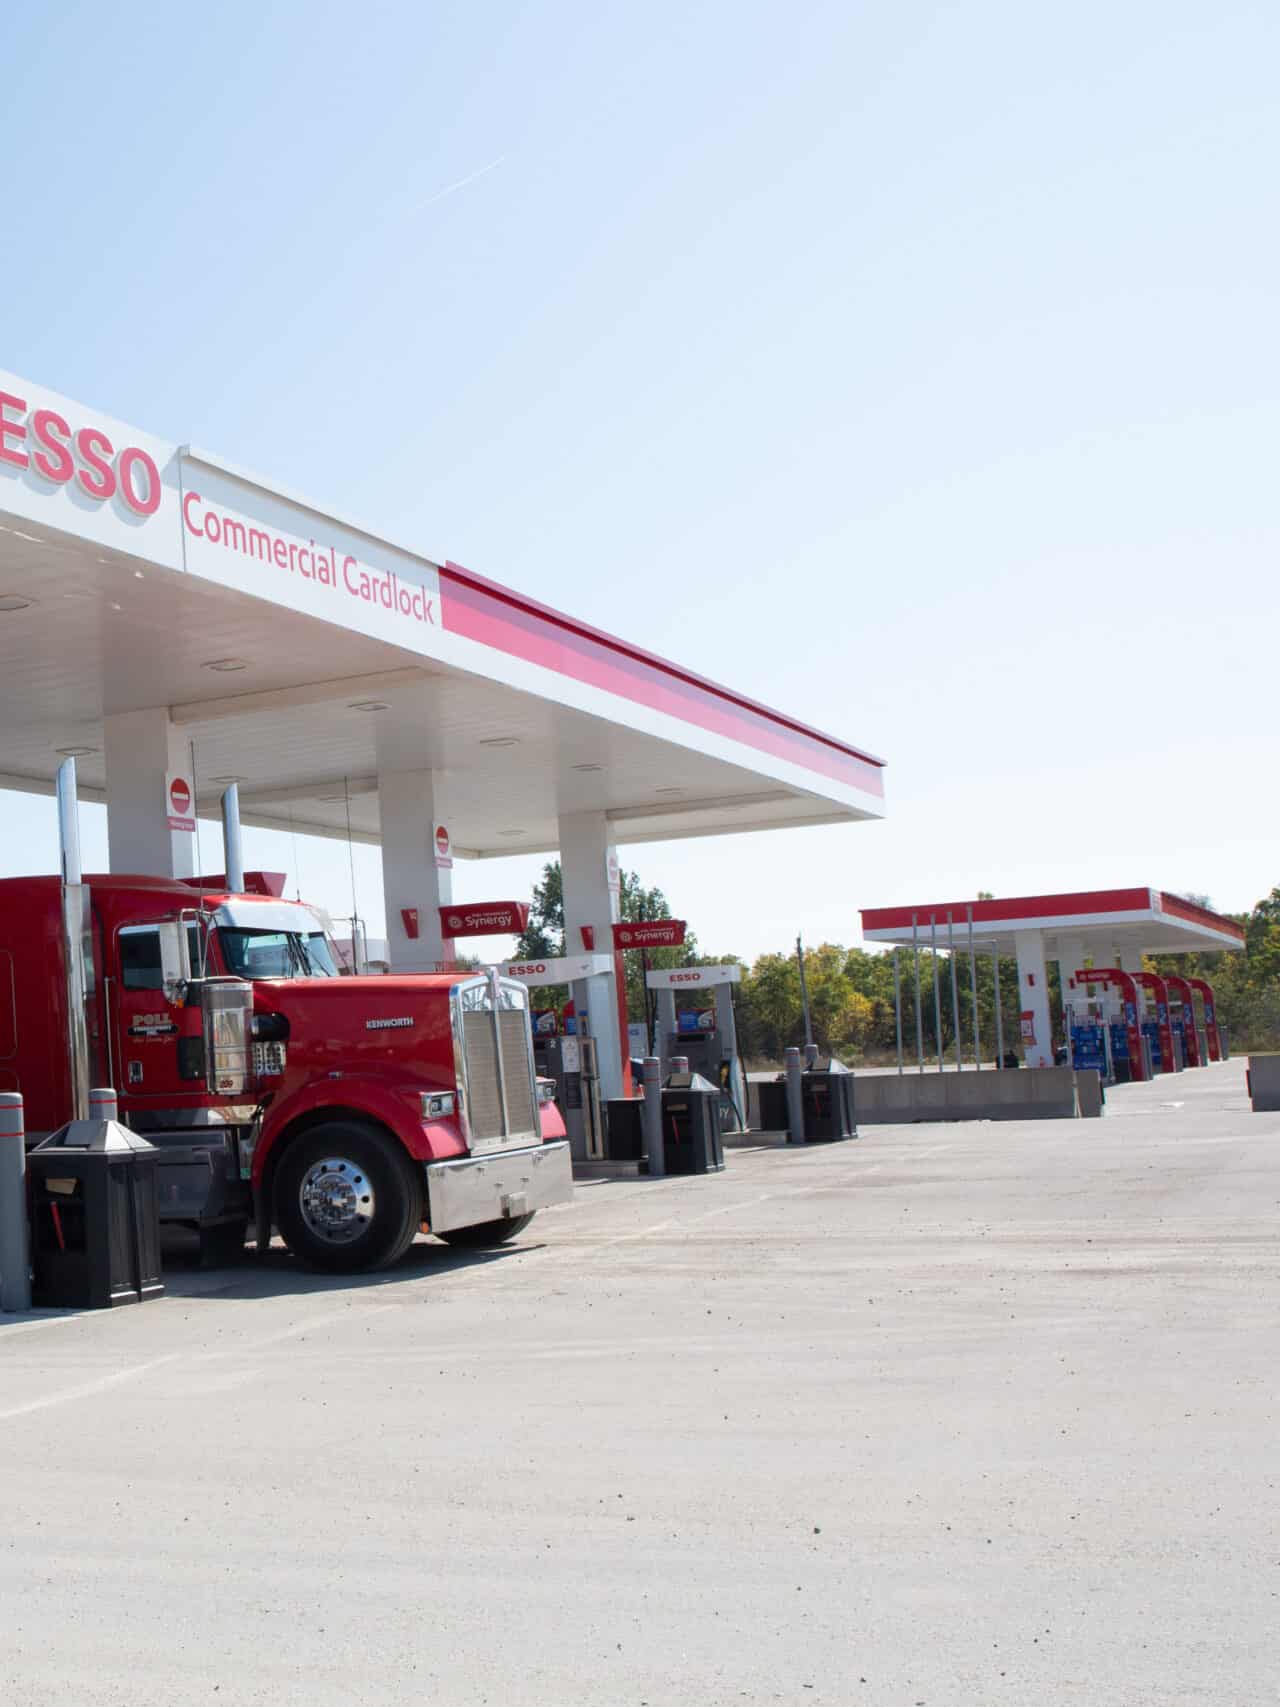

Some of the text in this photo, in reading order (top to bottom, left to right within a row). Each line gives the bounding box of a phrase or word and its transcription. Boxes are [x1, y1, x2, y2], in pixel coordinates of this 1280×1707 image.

[183, 491, 434, 625] Commercial Cardlock
[464, 914, 512, 928] Synergy
[634, 930, 675, 942] Synergy
[508, 963, 546, 976] ESSO
[669, 972, 701, 983] ESSO
[366, 1016, 414, 1029] KENWORTH
